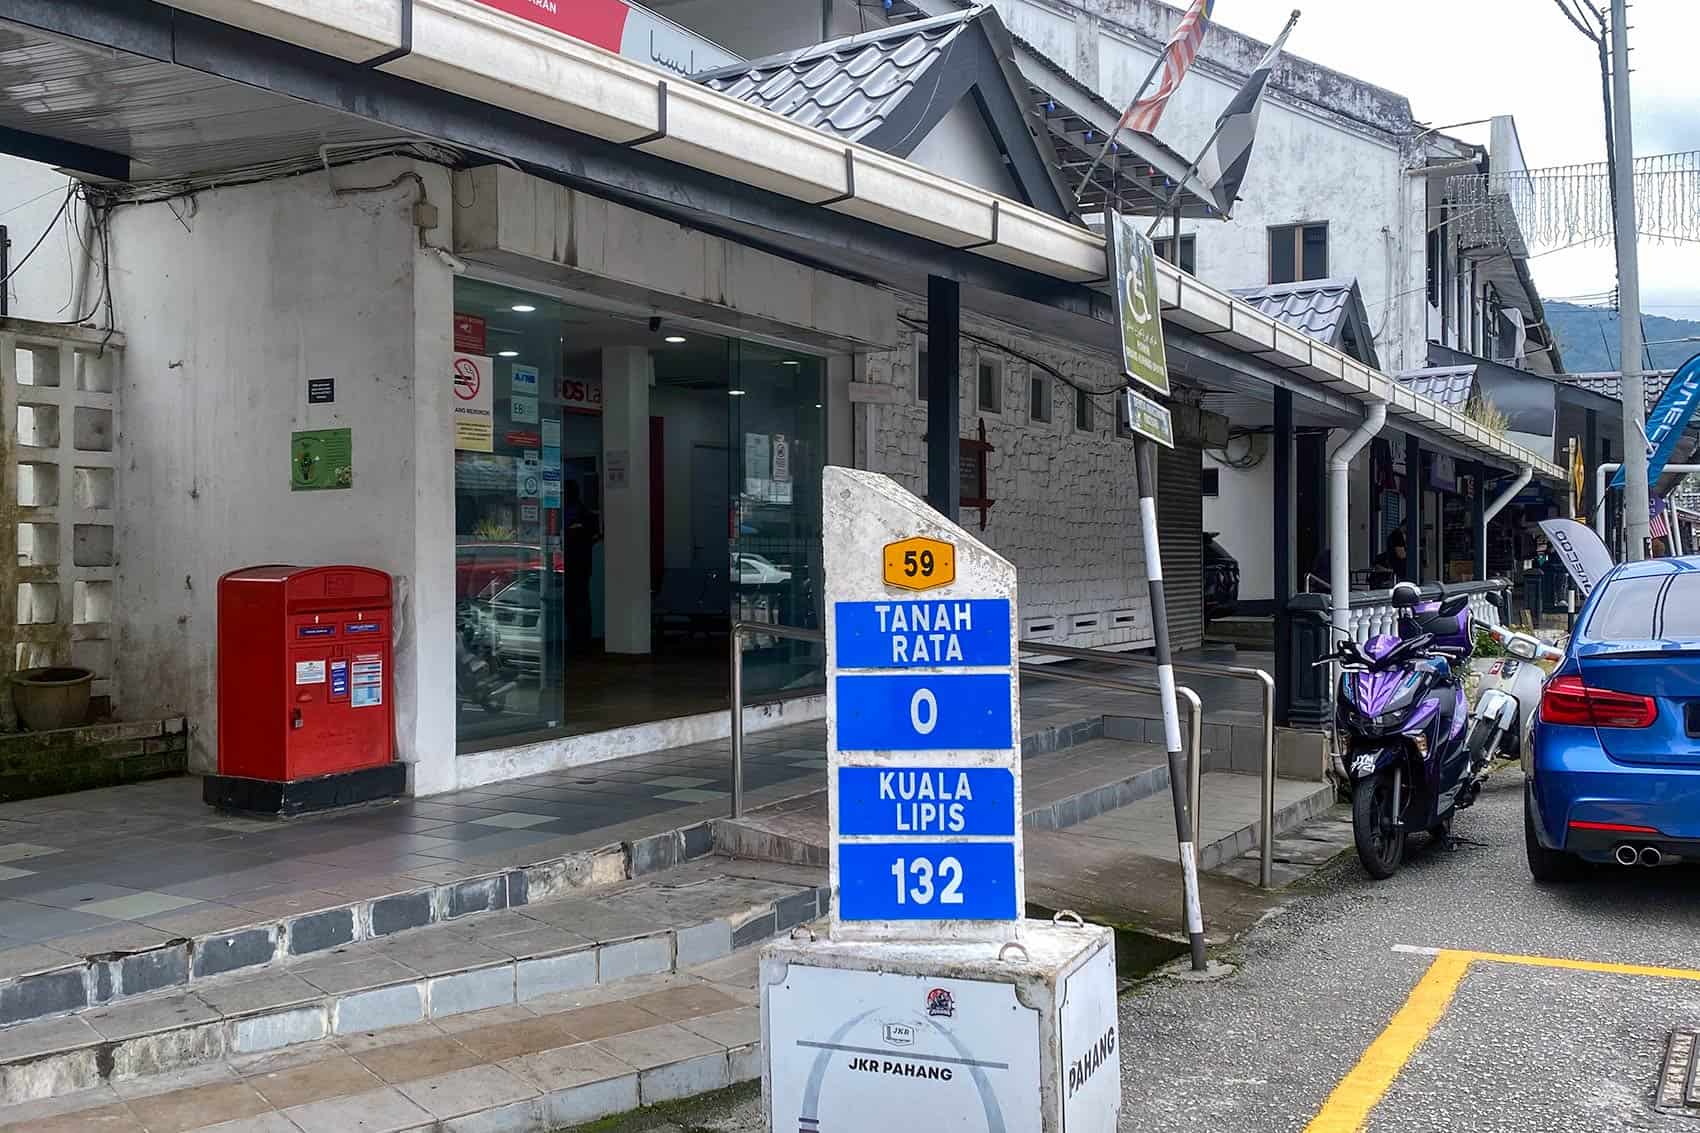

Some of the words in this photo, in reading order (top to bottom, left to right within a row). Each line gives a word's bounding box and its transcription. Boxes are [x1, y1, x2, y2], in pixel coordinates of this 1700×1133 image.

[903, 550, 934, 577] 59
[874, 603, 972, 633] TANAH
[892, 634, 964, 663] RATA
[910, 688, 938, 735] 0
[879, 771, 972, 801] KUALA
[896, 802, 966, 833] LIPIS
[891, 856, 964, 905] 132
[848, 1057, 879, 1073] JKR
[883, 1060, 953, 1081] PAHANG
[1068, 1026, 1115, 1099] PAHANG
